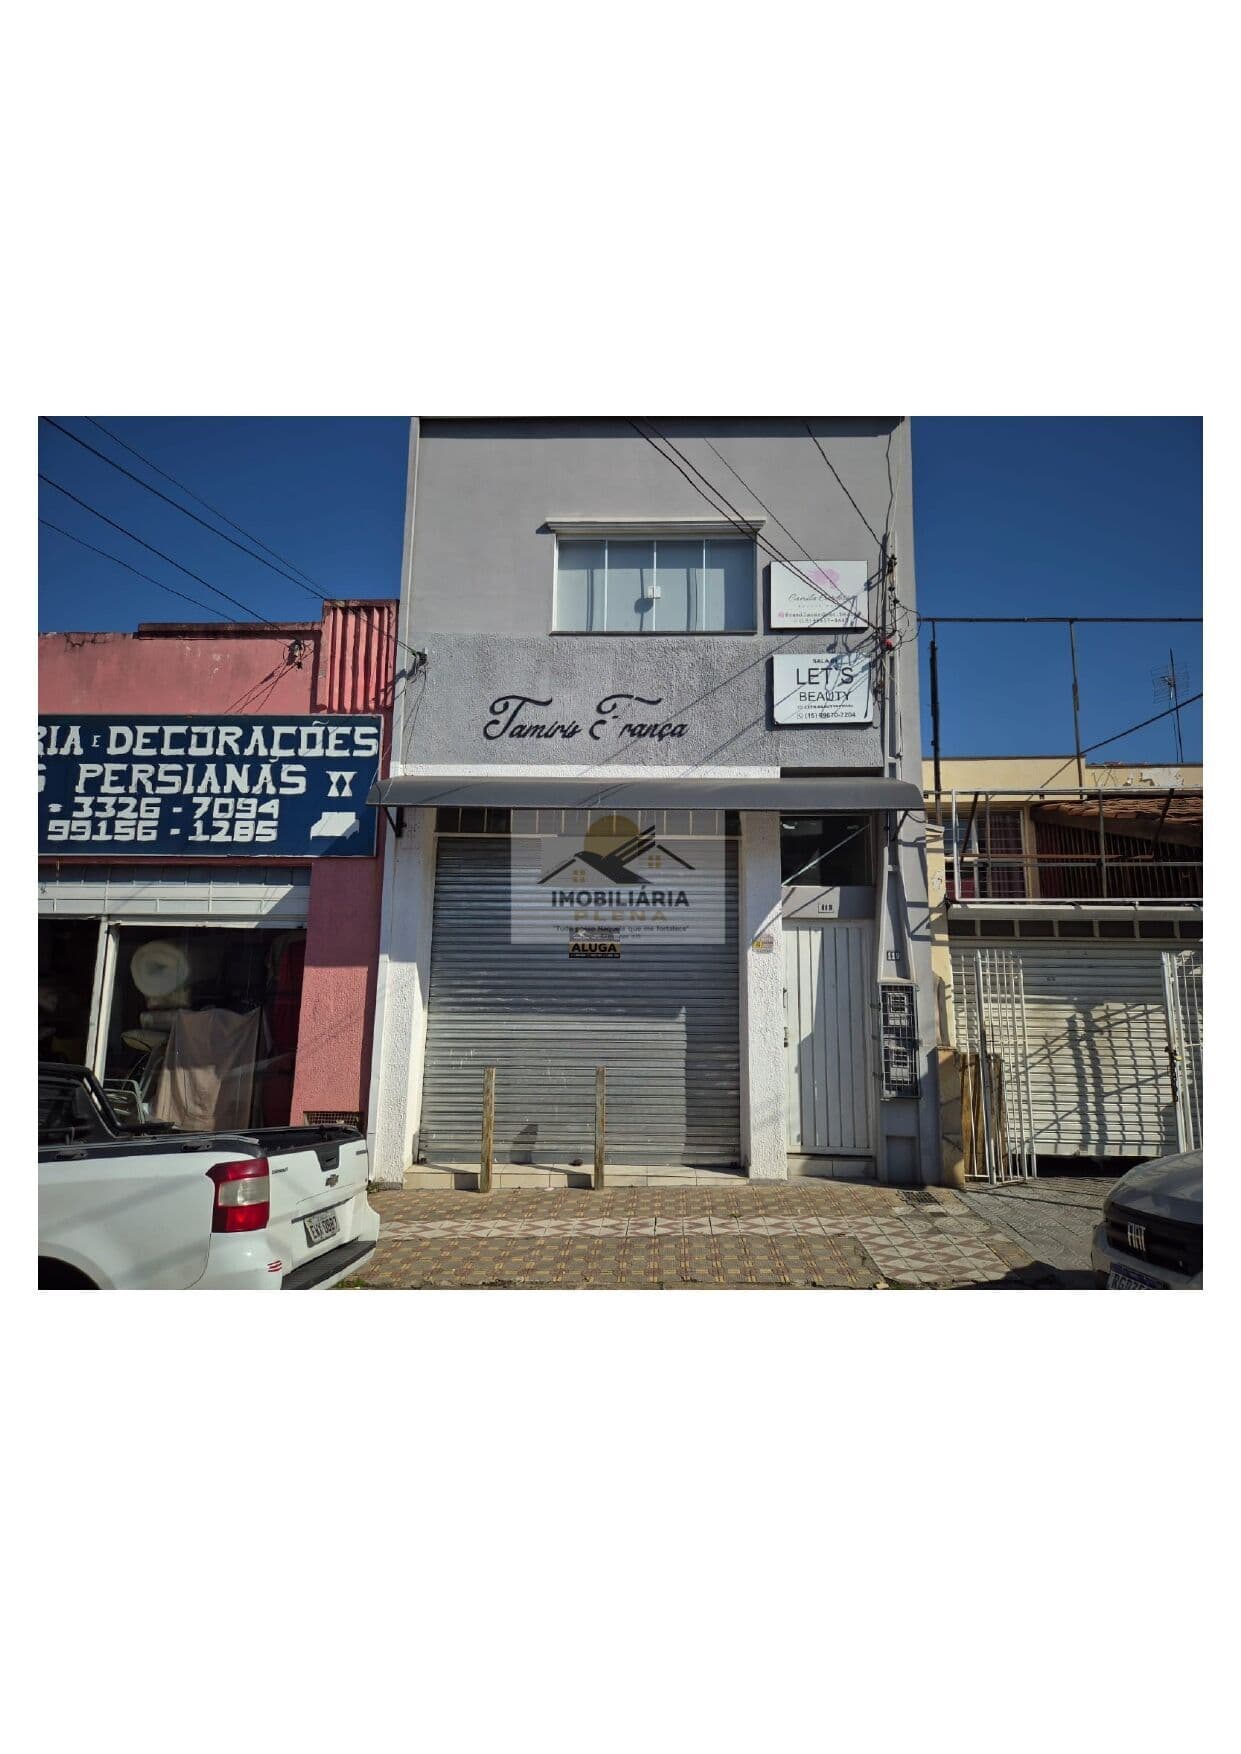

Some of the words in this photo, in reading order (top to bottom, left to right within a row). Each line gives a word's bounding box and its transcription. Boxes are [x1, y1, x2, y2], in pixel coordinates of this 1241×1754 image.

[799, 691, 851, 702] BEAUTY
[482, 694, 583, 741] Tamiris
[91, 735, 101, 748] E
[106, 720, 379, 763] DECORAÇÕES
[75, 763, 308, 795] PERSIANAS
[72, 796, 162, 819] 3326
[192, 796, 280, 820] 7094
[47, 819, 160, 842] 99156
[188, 819, 279, 843] 1285
[571, 942, 617, 953] ALUGA
[1127, 1221, 1146, 1252] FIAT
